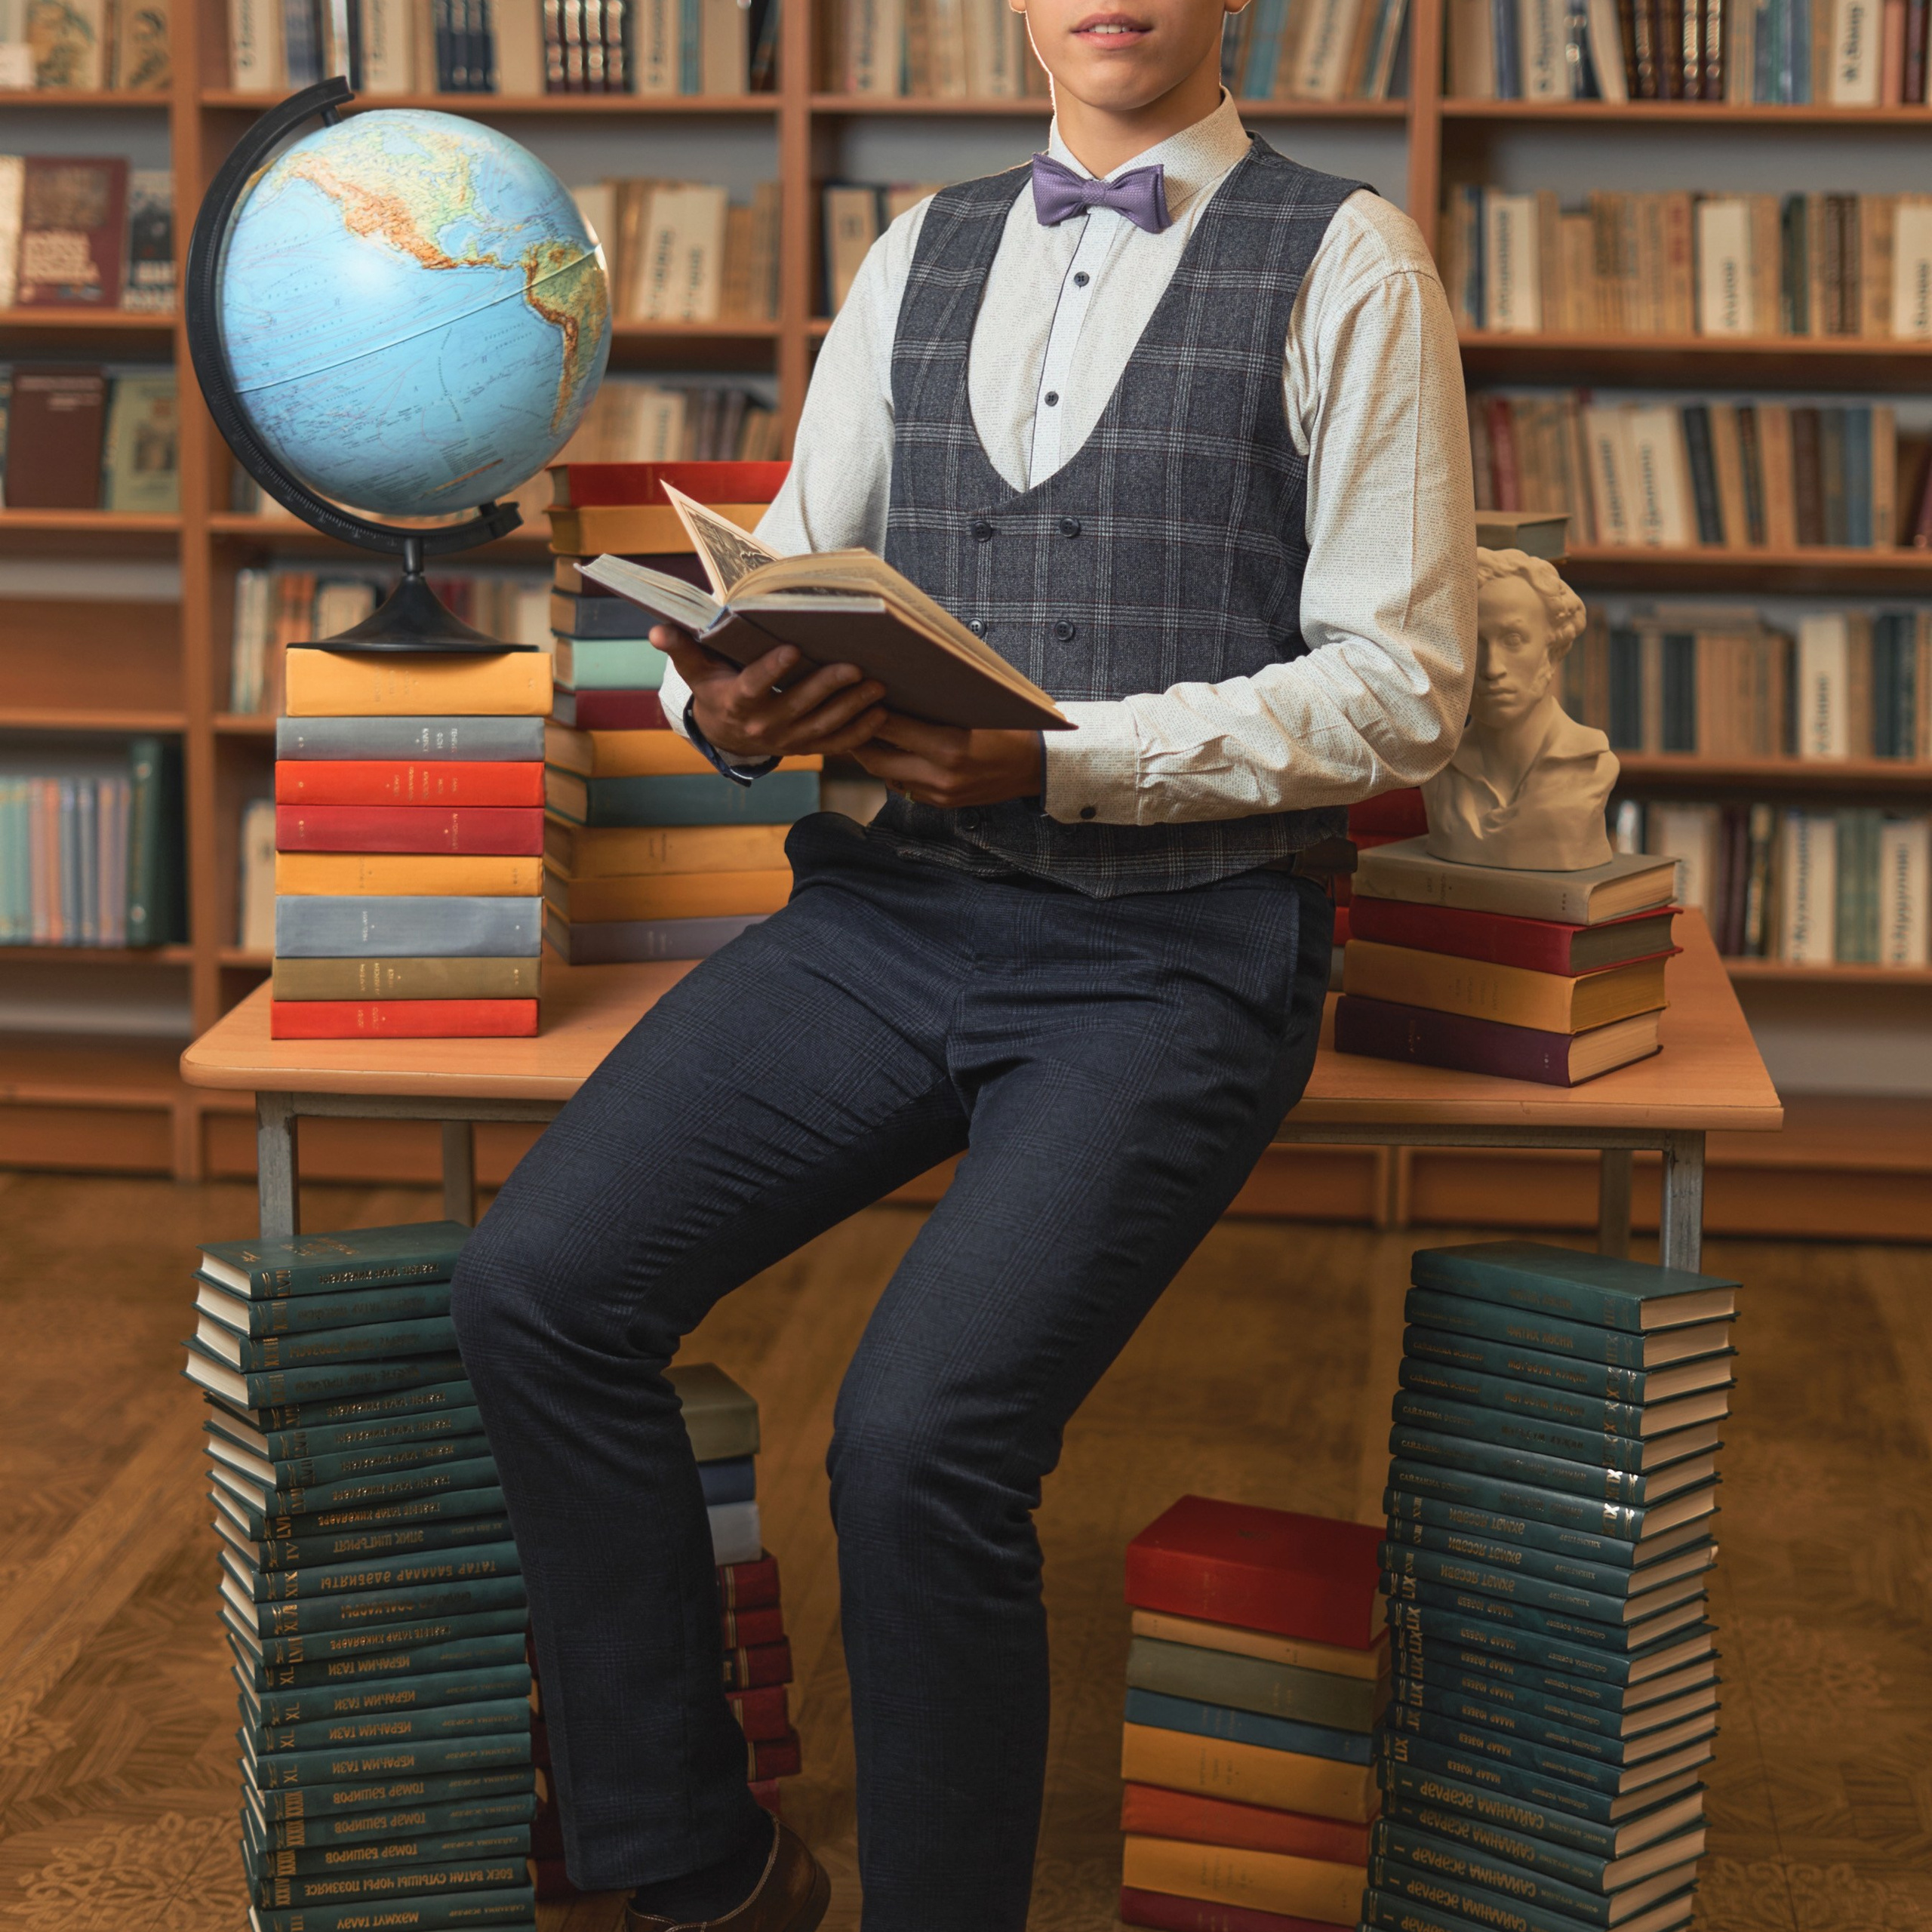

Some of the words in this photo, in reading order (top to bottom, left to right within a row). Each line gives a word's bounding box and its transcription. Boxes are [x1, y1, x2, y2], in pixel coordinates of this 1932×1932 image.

[1450, 1507, 1487, 1527] ЯССӘВИ
[1492, 1514, 1524, 1535] ӘХМӘТ
[394, 1530, 423, 1544] ЭПИК
[1448, 1537, 1486, 1555] ЯССӘВИ
[286, 1542, 299, 1559] IV
[1488, 1546, 1521, 1565] ӘХМӘТ
[397, 1564, 452, 1580] БАЛАЛАР
[458, 1560, 496, 1574] ТАТАР
[1441, 1564, 1478, 1583] ЯССӘВИ
[321, 1571, 391, 1589] ӘДӘБИЯТЫ
[1482, 1574, 1515, 1592] ӘХМӘТ
[280, 1666, 294, 1684] XL
[328, 1662, 355, 1675] ГАЗИ
[286, 1702, 300, 1720] XL
[334, 1698, 360, 1710] ГАЗИ
[280, 1730, 294, 1748] XL
[329, 1727, 355, 1739] ГАЗИ
[1395, 1737, 1408, 1761] LIX
[283, 1764, 297, 1783] XL
[332, 1761, 359, 1773] ГАЗИ
[334, 1787, 386, 1804] БӘШИРОВ
[390, 1782, 423, 1796] ГОМӘР
[1420, 1782, 1474, 1809] ӘСӘРЛӘР
[391, 1813, 425, 1826] ГОМӘР
[1478, 1797, 1544, 1829] САЙЛАНМА
[335, 1817, 387, 1833] БӘШИРОВ
[1420, 1811, 1469, 1838] ӘСӘРЛӘР
[382, 1843, 417, 1857] ГОМӘР
[1472, 1827, 1535, 1863] САЙЛАНМА
[325, 1847, 378, 1863] БӘШИРОВ
[1412, 1847, 1465, 1875] ӘСӘРЛӘР
[364, 1878, 394, 1890] ЧОРЫ
[398, 1873, 447, 1887] СУГЫШЫ
[450, 1870, 483, 1882] ВАТАН
[1469, 1863, 1536, 1898] САЙЛАНМА
[304, 1880, 360, 1896] ПОЭЗИЯСЕ
[1407, 1880, 1459, 1909] ӘСӘРЛӘР
[1463, 1897, 1527, 1932] САЙЛАНМА
